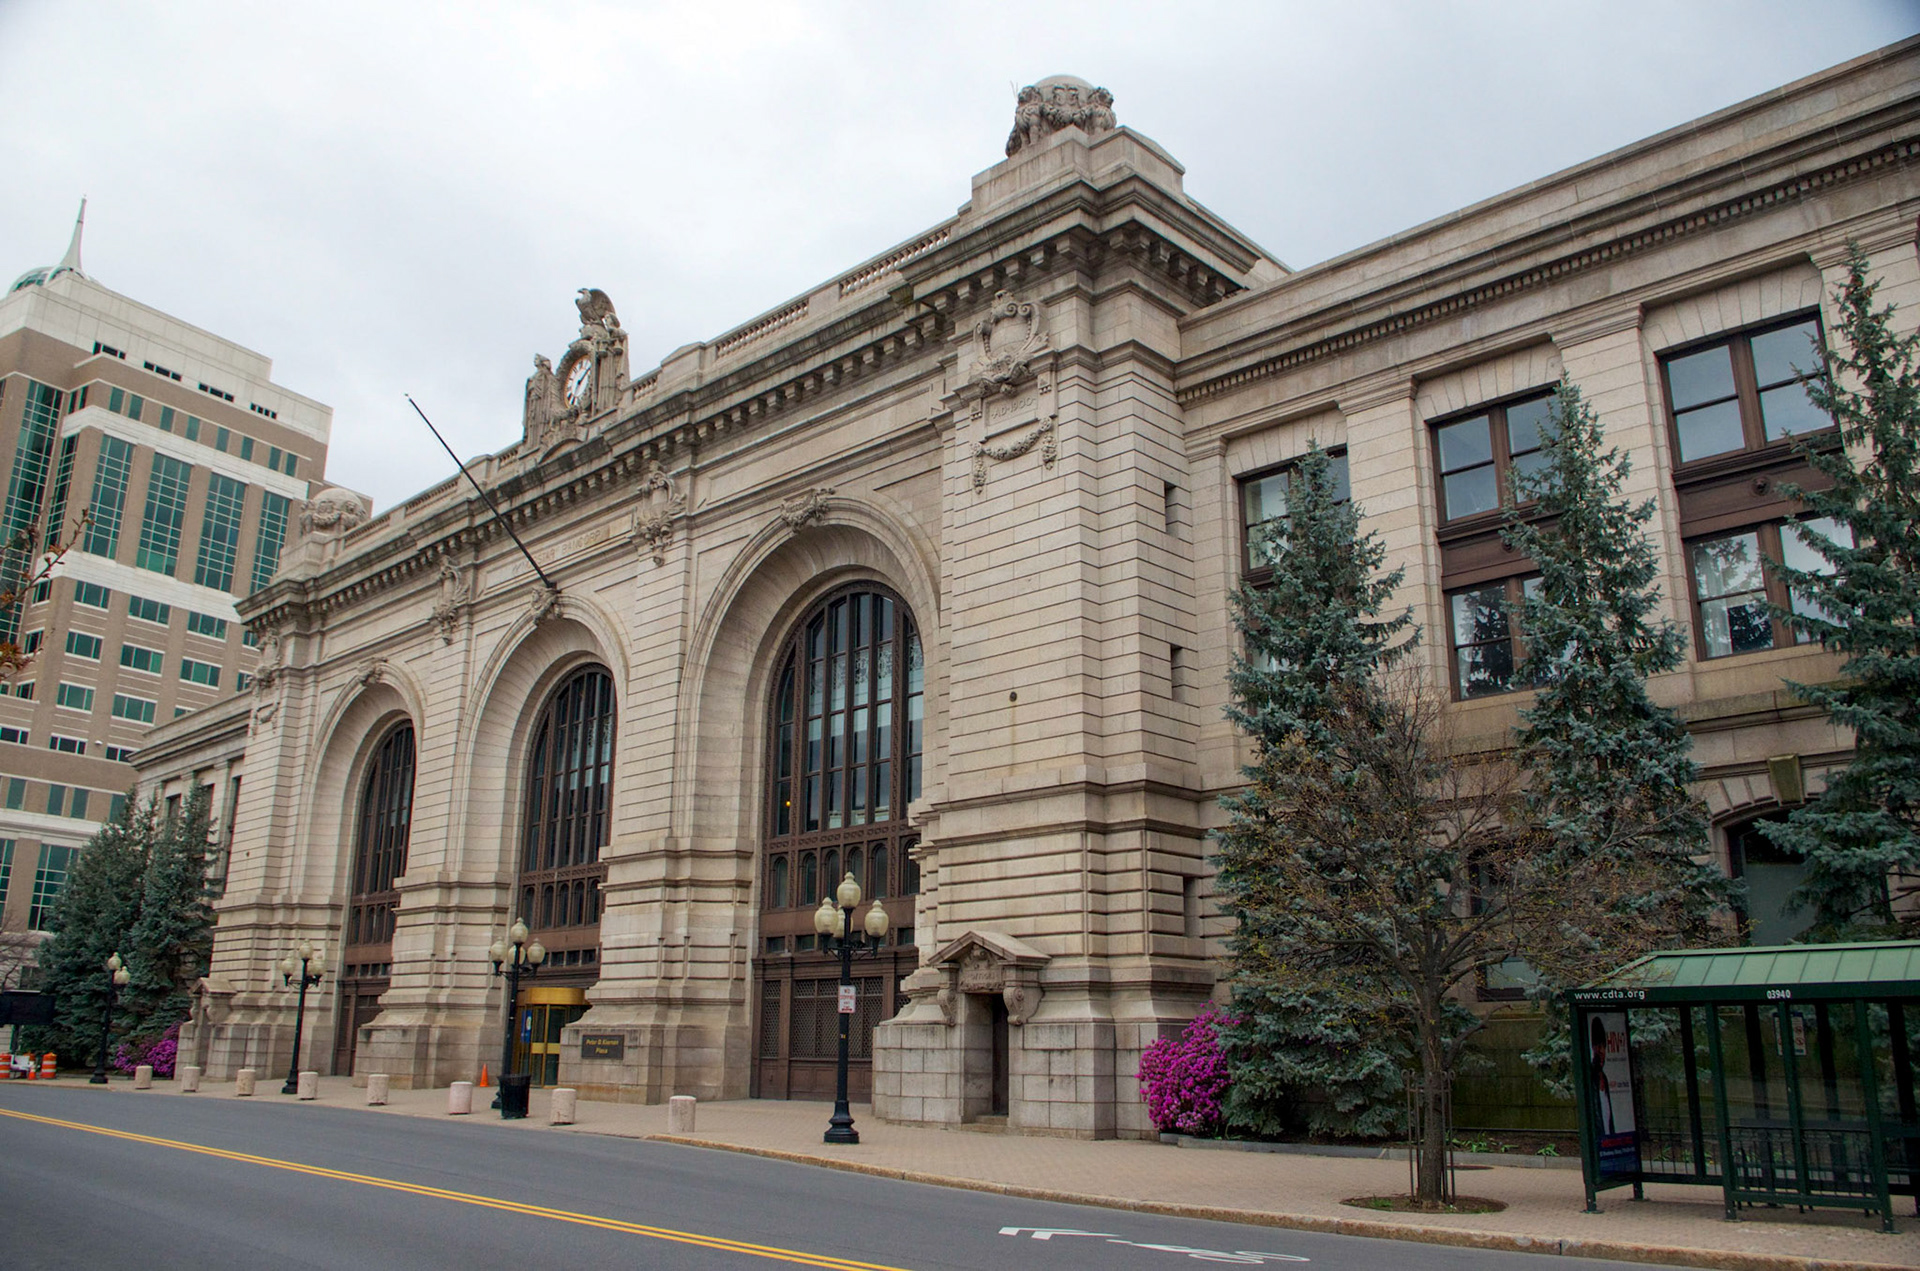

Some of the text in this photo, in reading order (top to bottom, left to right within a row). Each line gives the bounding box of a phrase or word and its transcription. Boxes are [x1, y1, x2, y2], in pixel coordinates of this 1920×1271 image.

[562, 529, 602, 555] BANCORP
[1574, 989, 1645, 1000] www.cdta.org
[1766, 989, 1791, 999] 03940
